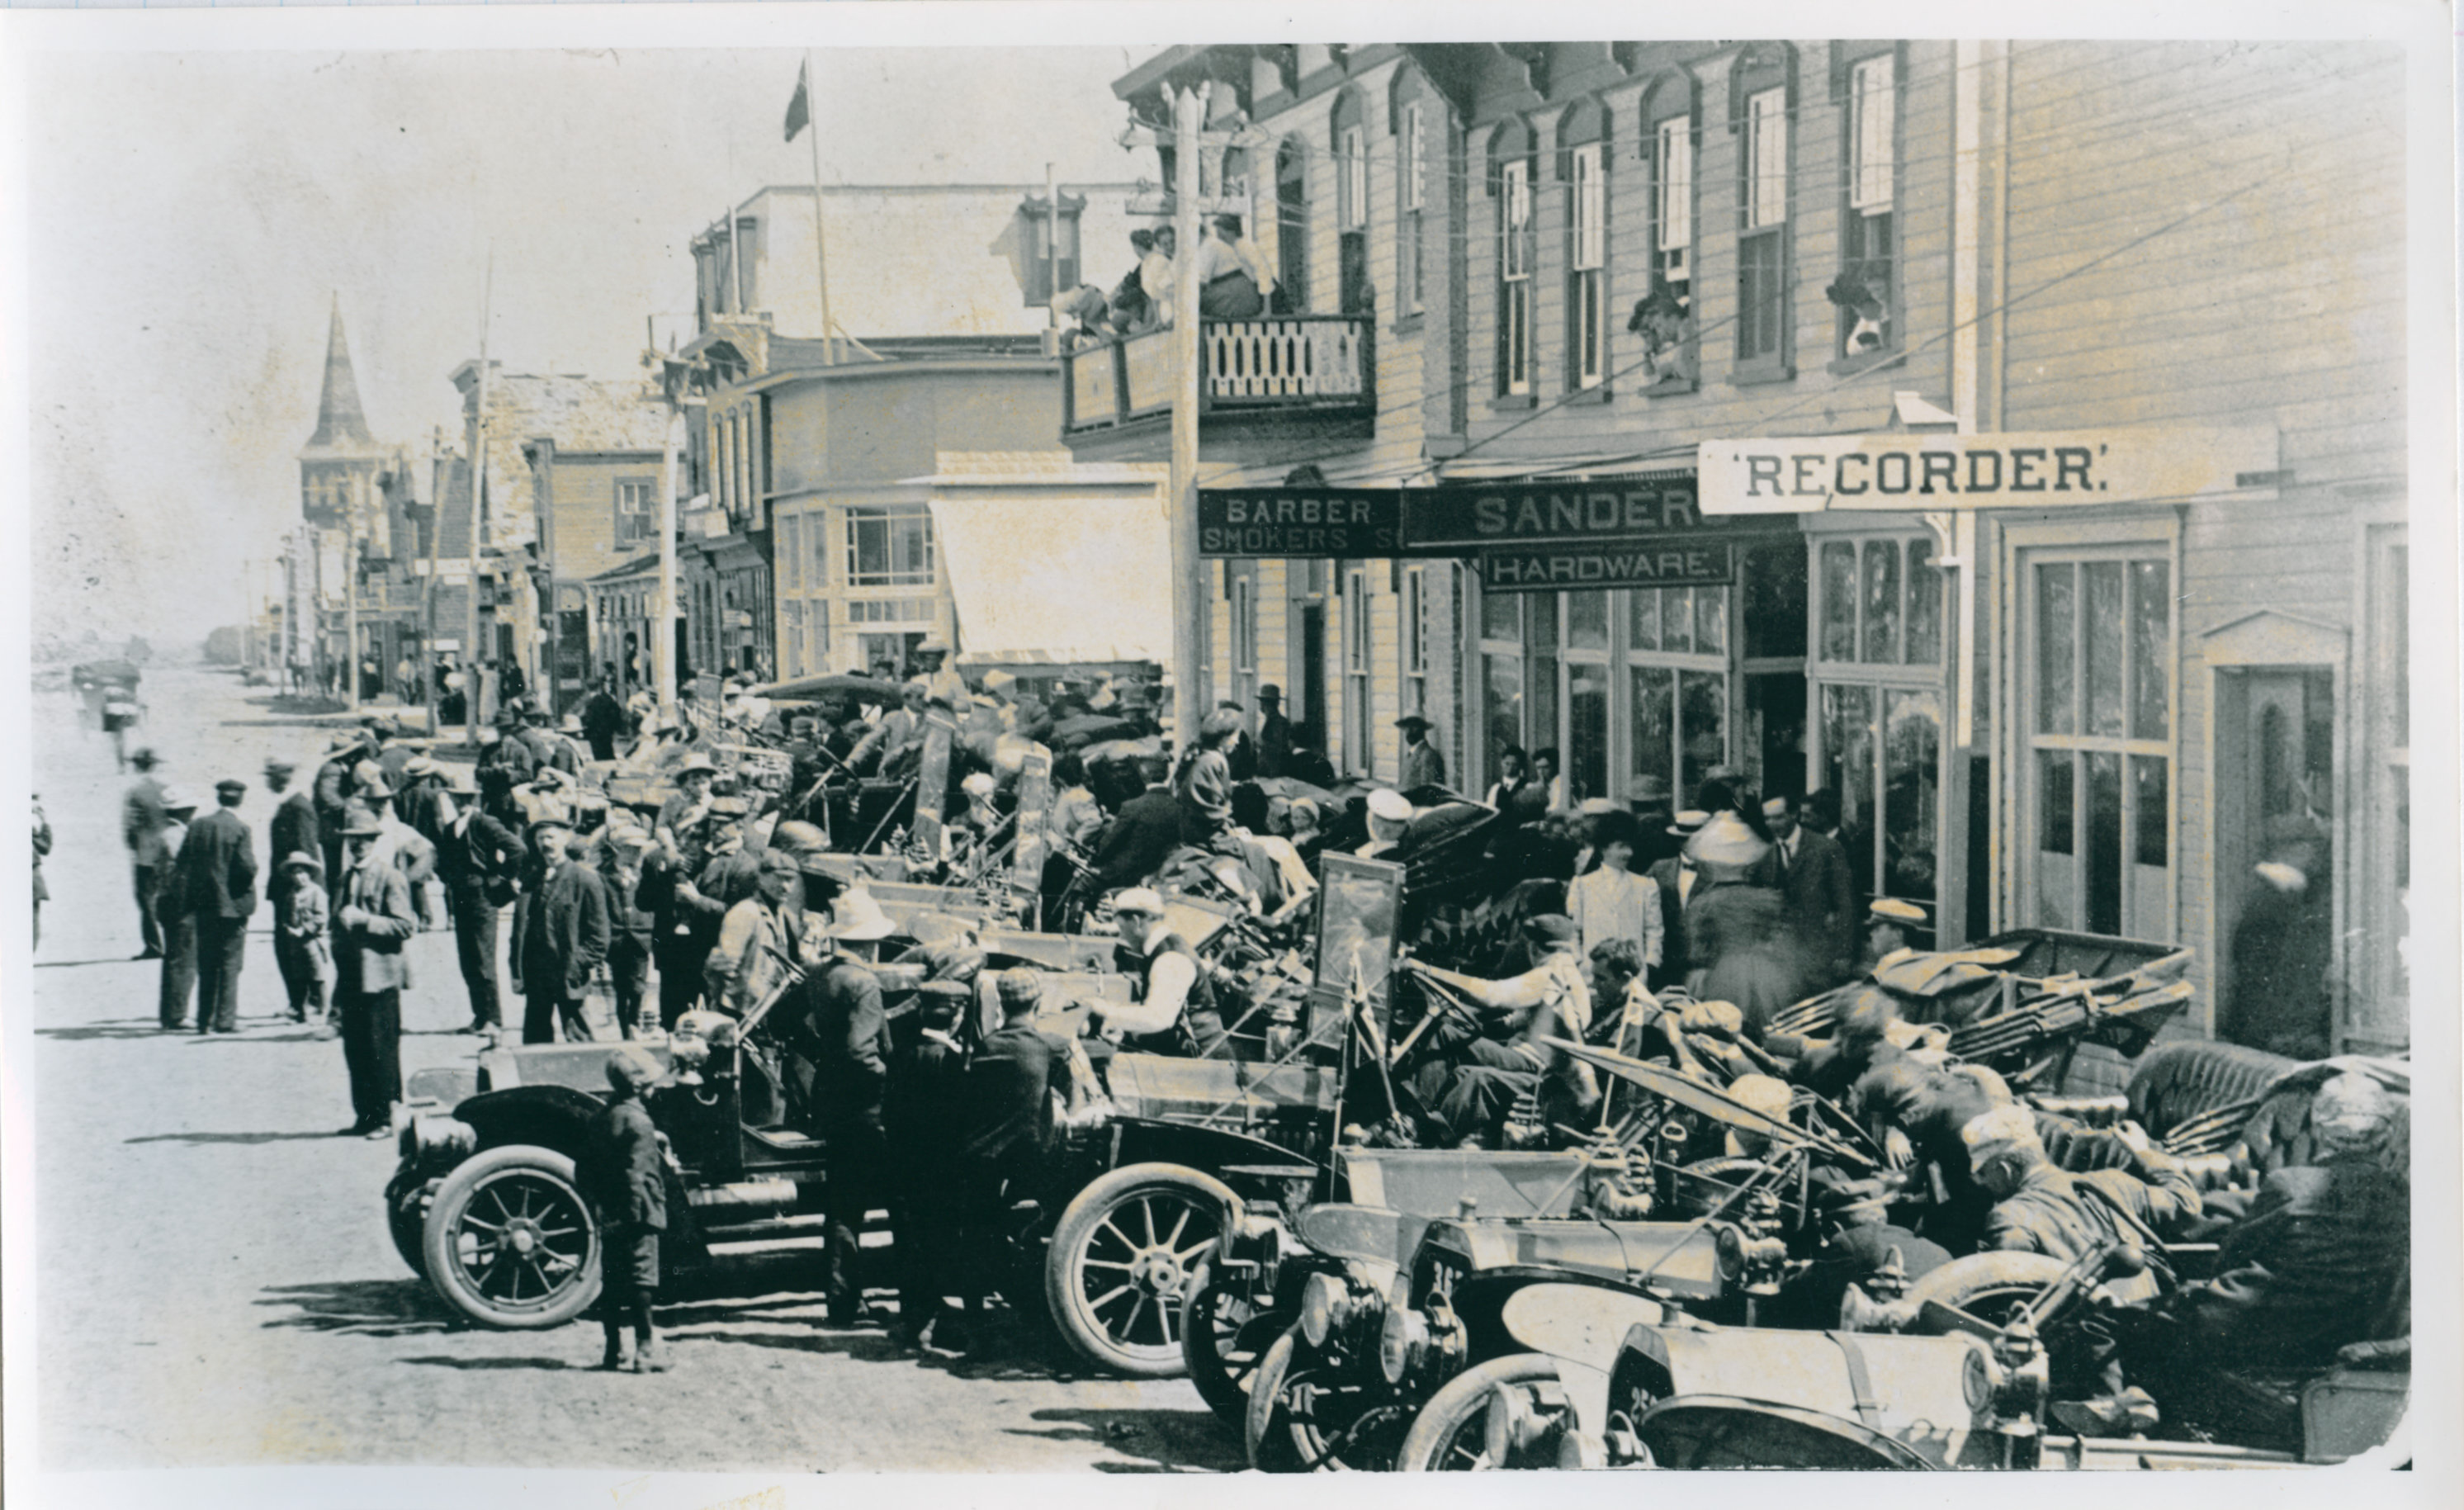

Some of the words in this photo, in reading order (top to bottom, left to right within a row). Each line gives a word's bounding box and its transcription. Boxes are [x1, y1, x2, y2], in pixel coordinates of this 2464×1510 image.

[1227, 499, 1371, 524] BARBER
[1474, 490, 1731, 533] SANDER
[1203, 527, 1348, 551] SMOKERS
